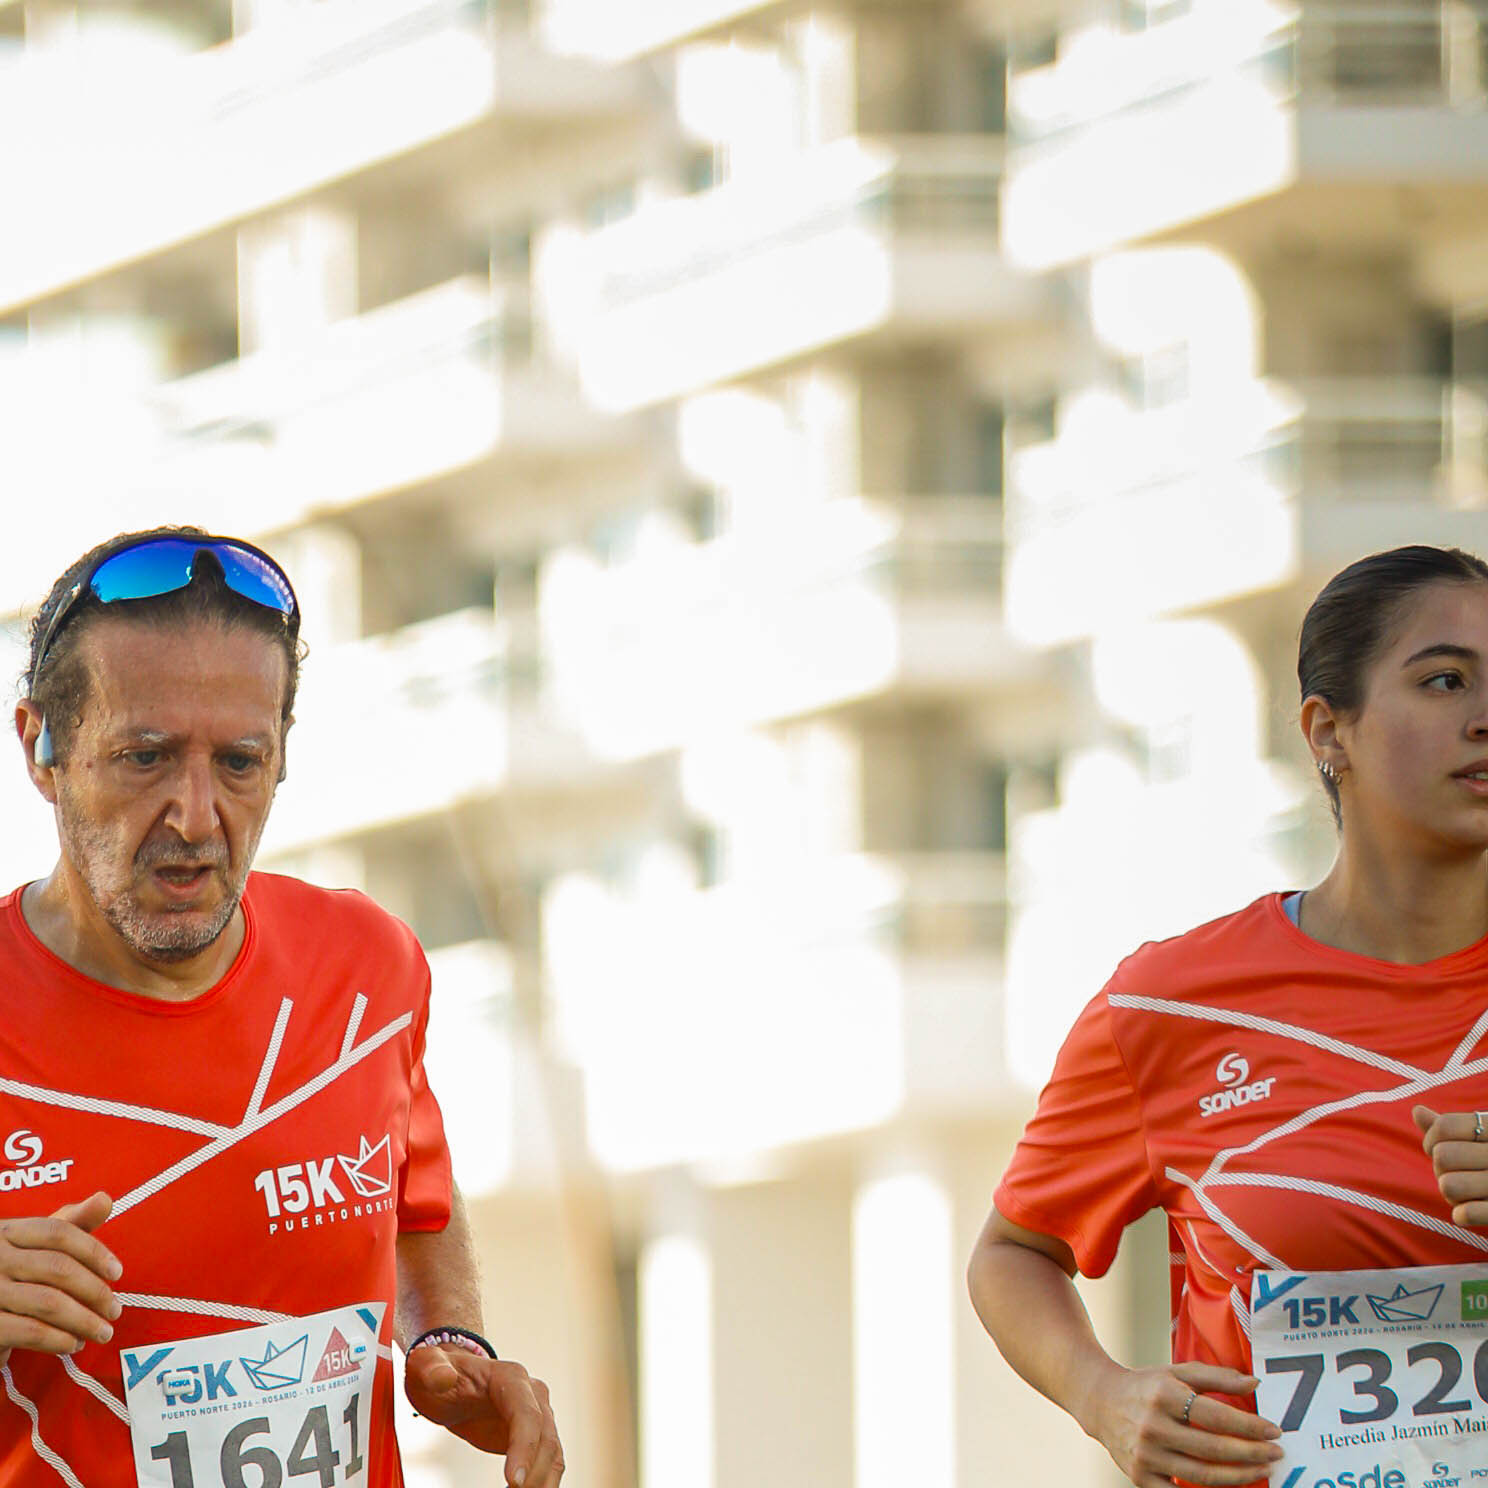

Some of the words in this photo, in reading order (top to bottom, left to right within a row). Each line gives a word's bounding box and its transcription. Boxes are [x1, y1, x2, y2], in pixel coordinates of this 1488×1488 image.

[254, 1157, 345, 1218] 15K
[1282, 1295, 1361, 1329] 15K
[168, 1378, 191, 1388] HOKA
[1264, 1338, 1488, 1433] 732
[161, 1409, 197, 1421] PUERTO
[199, 1404, 229, 1416] NORTE
[262, 1390, 297, 1404] ROSARIO
[1320, 1427, 1386, 1450] Heredia
[1451, 1415, 1488, 1435] Mai
